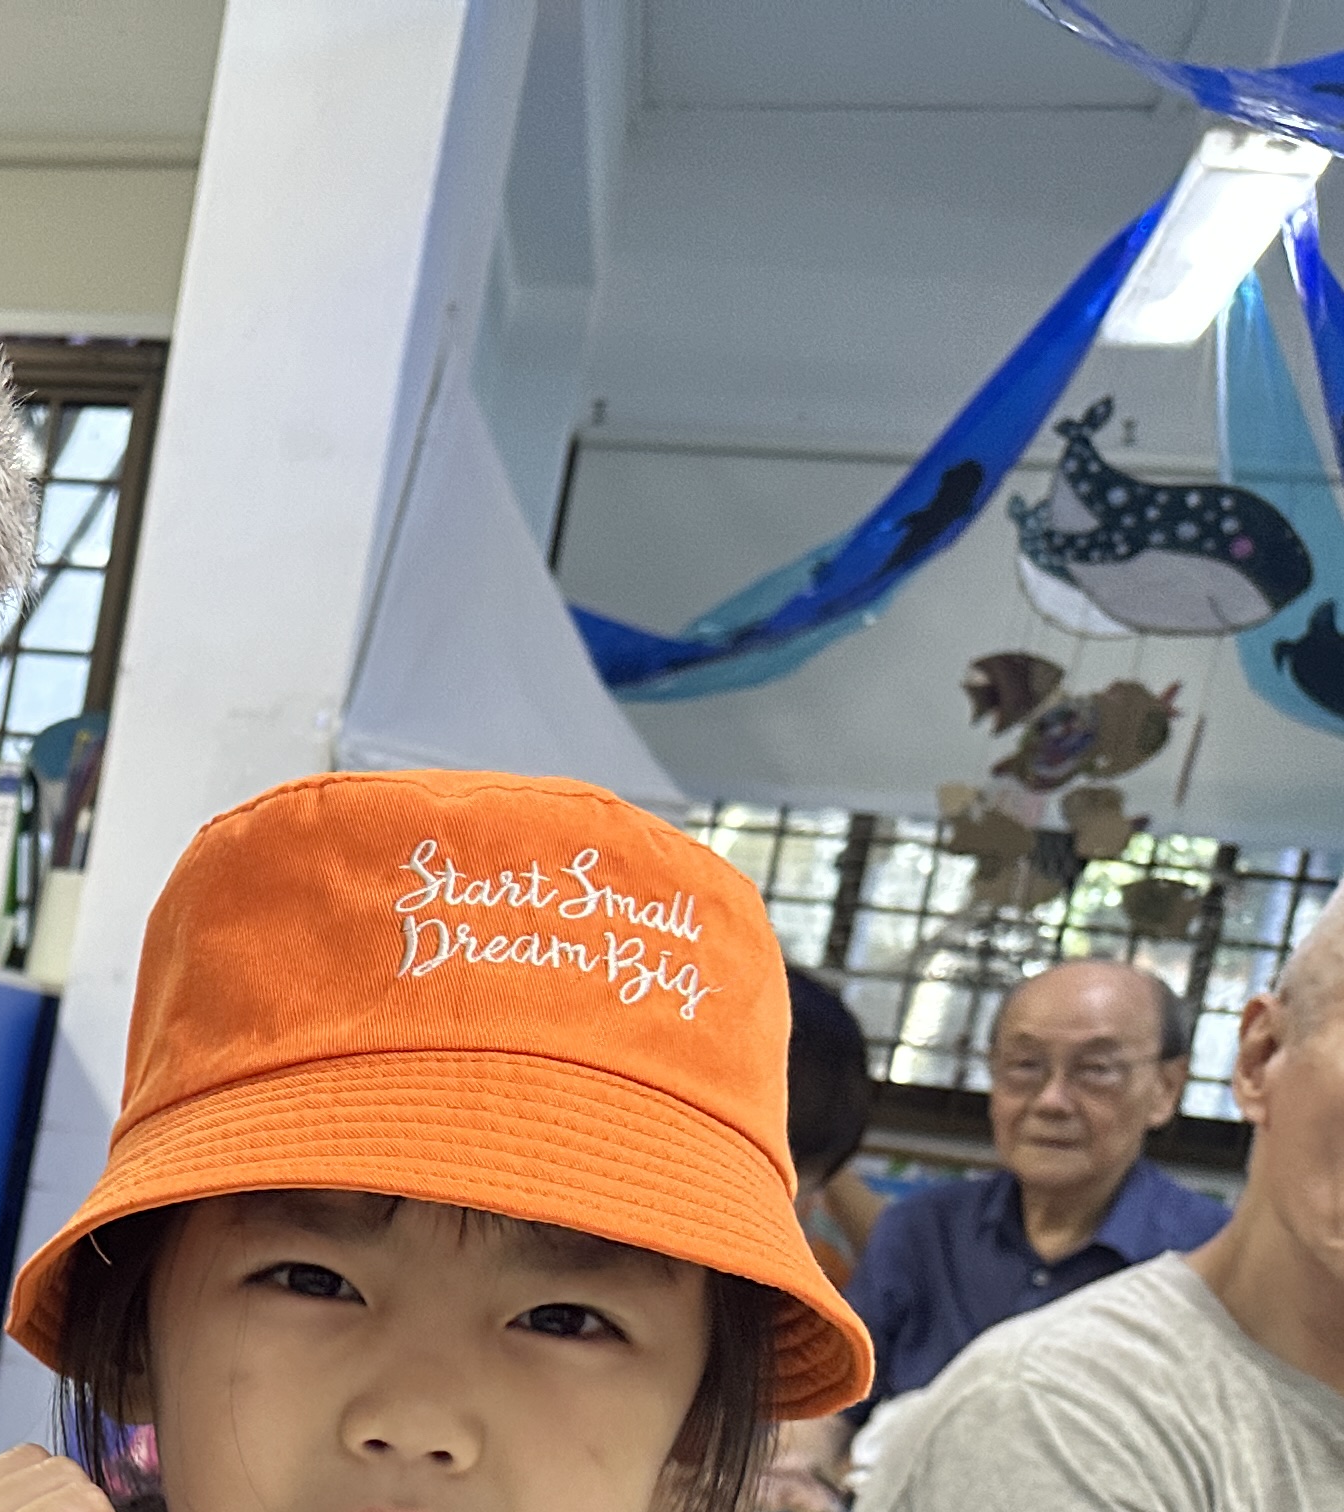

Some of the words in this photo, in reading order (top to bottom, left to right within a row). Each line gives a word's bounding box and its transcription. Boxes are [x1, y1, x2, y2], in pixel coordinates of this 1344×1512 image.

[395, 839, 558, 913] Start
[558, 848, 703, 943] Small
[397, 915, 600, 978] Dream
[603, 931, 720, 1020] Big
